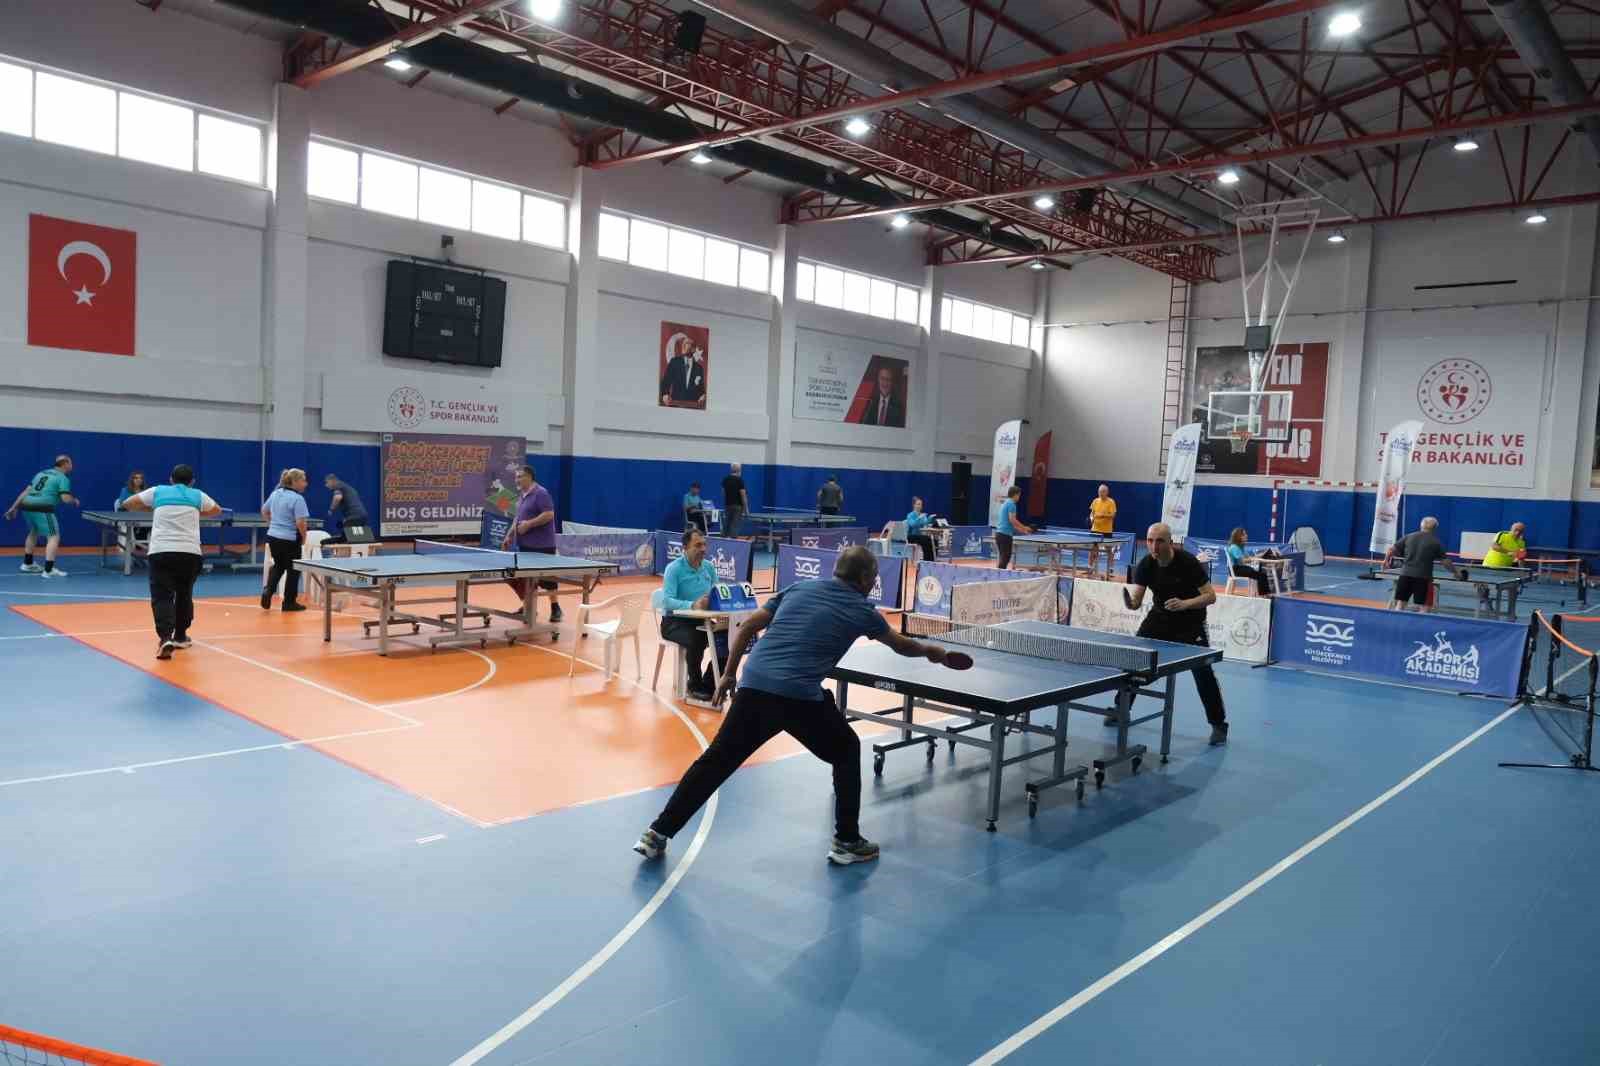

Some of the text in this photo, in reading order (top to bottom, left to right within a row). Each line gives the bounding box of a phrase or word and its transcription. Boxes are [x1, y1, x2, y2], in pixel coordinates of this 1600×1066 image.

[448, 401, 485, 413] GENÇLİK
[488, 404, 498, 413] VE
[430, 412, 499, 424] SPOR BAKANLIĞI
[1266, 428, 1312, 462] ULAŞ
[1417, 430, 1494, 448] GENÇLİK
[1501, 434, 1525, 447] VE
[1427, 450, 1524, 466] BAKANLIĞI
[385, 503, 485, 522] HOŞ GELDİNİZ
[720, 585, 754, 598] 0 2
[1425, 651, 1461, 665] SPOR
[1406, 658, 1480, 680] AKADEMİSİ
